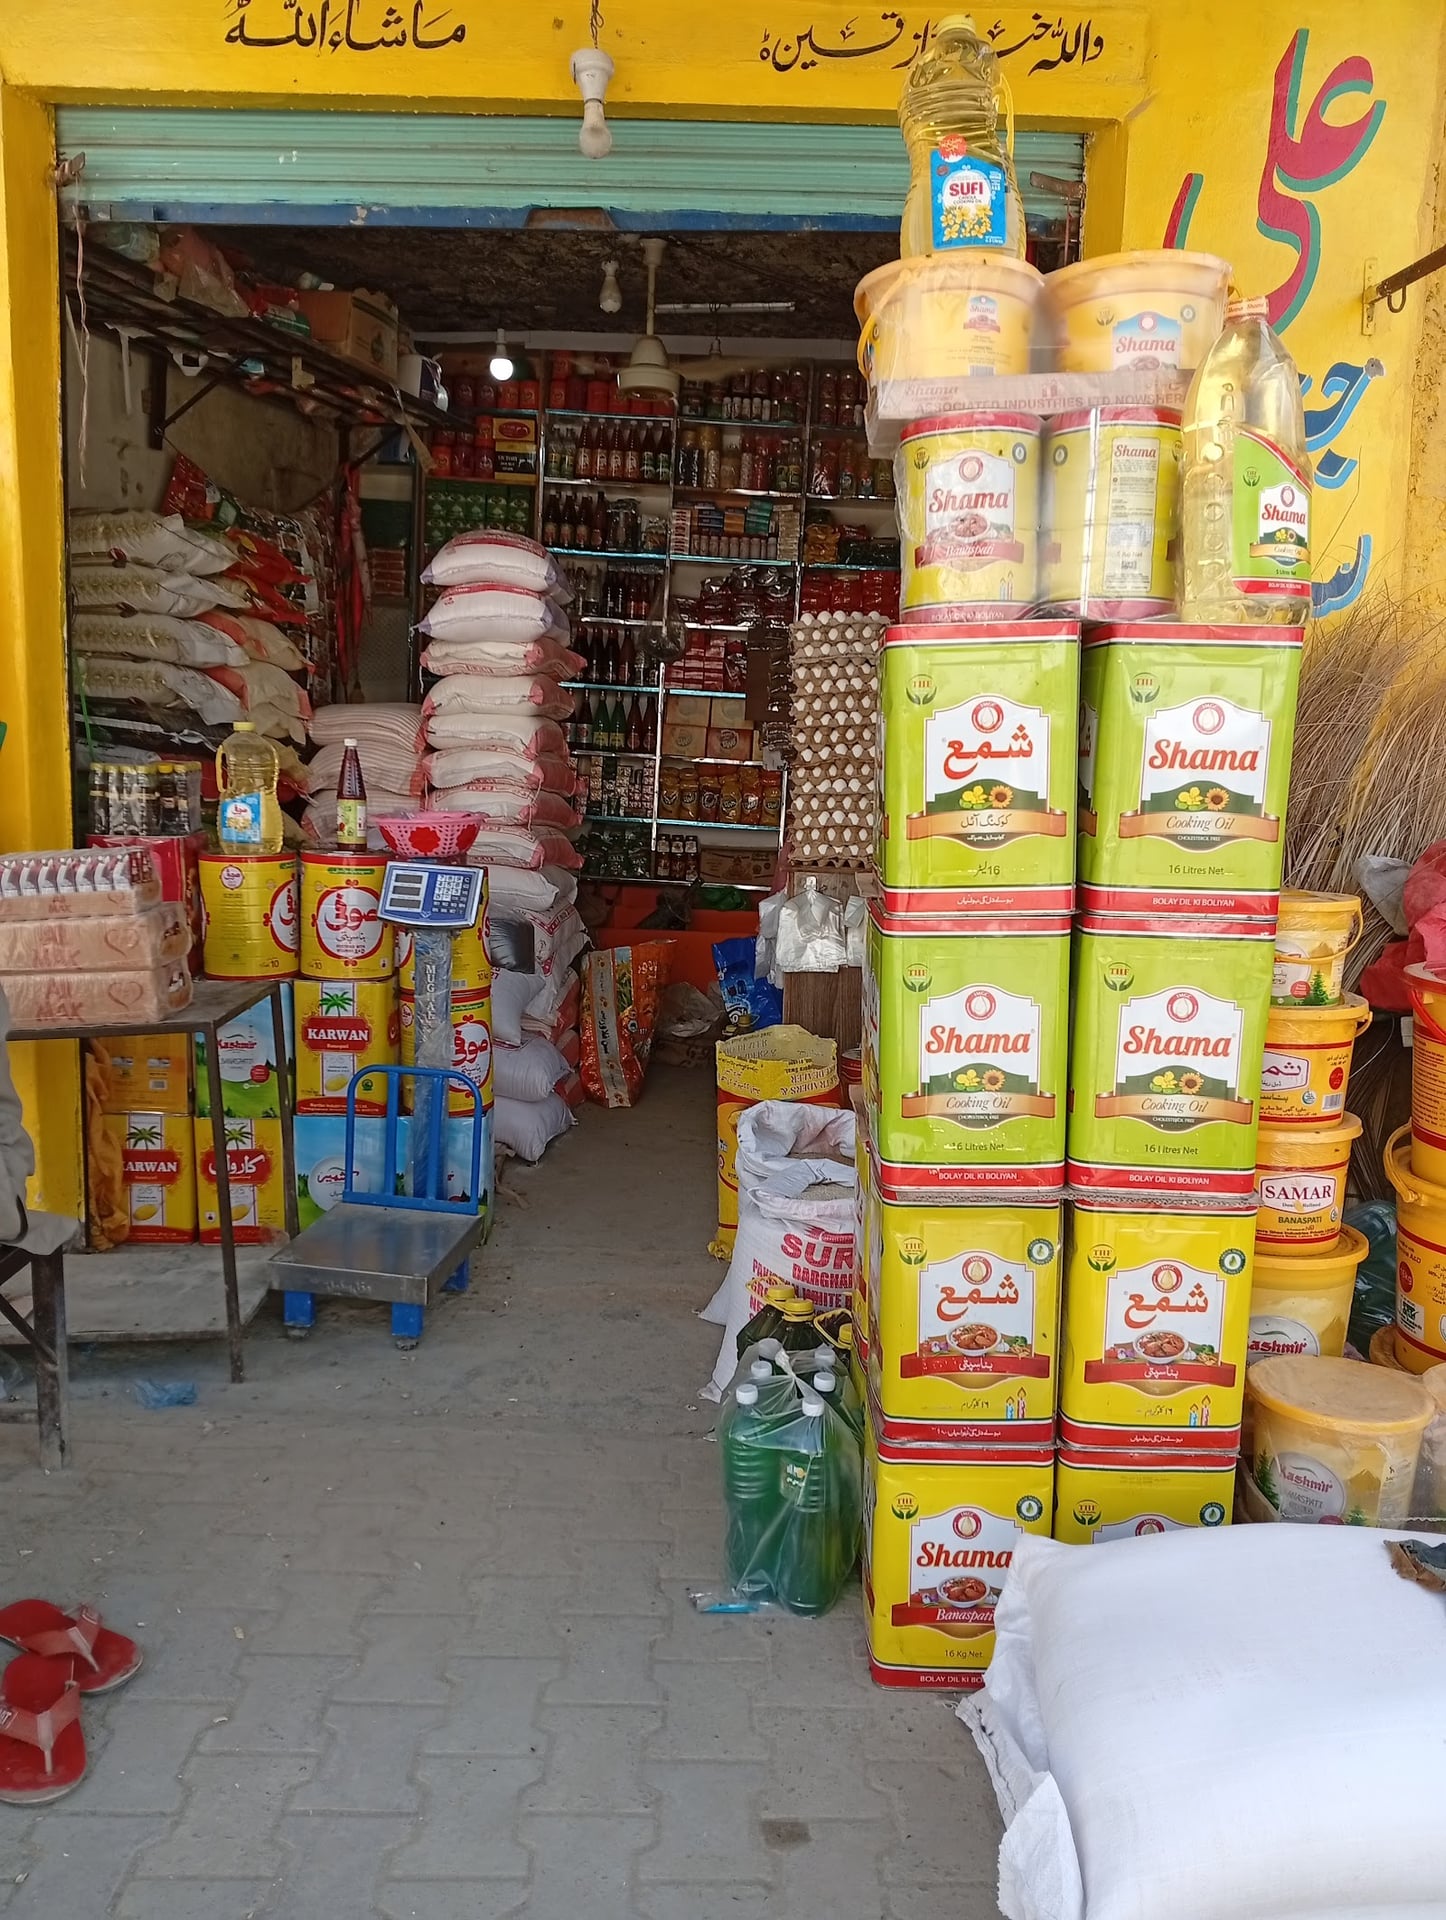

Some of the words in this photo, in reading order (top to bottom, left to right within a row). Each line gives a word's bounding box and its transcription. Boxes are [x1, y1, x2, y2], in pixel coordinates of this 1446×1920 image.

[949, 181, 983, 196] SUFI
[1115, 335, 1176, 354] Shama
[1004, 397, 1084, 409] INDUSTRIES
[1116, 393, 1185, 406] NOWSHER
[1114, 444, 1157, 458] Shama
[928, 488, 1010, 513] Shama
[1261, 503, 1307, 524] Shama
[943, 723, 1034, 780] شمع
[1149, 739, 1259, 772] Shama
[1166, 815, 1212, 831] Cooking
[1214, 816, 1236, 830] Oil
[989, 866, 1001, 875] 16
[1168, 864, 1180, 874] 16
[1182, 865, 1207, 874] Litres
[1208, 867, 1224, 875] Net
[1152, 897, 1178, 905] BOLAY
[1179, 898, 1192, 906] DIL
[1202, 899, 1235, 907] BOLIYAN
[271, 960, 280, 968] 10
[307, 1028, 369, 1041] KARWAN
[925, 1025, 1032, 1054] Shama
[1123, 1026, 1231, 1057] Shama
[790, 1079, 830, 1096] TRADERS
[946, 1097, 989, 1111] Cooking
[992, 1096, 1012, 1109] Oil
[1141, 1098, 1186, 1113] Cooking
[1188, 1100, 1209, 1113] Oil
[952, 1142, 963, 1151] 16
[965, 1142, 988, 1151] Litres
[989, 1143, 1005, 1151] Net
[1144, 1144, 1156, 1152] 16
[1158, 1145, 1181, 1154] Litres
[1183, 1146, 1199, 1155] Net
[938, 1172, 963, 1180] BOLAY
[964, 1172, 977, 1180] DIL
[1129, 1174, 1155, 1182] BOLAY
[1155, 1175, 1167, 1183] DIL
[1177, 1177, 1210, 1185] BOLIYAN
[1265, 1185, 1332, 1200] SAMAR
[1278, 1216, 1322, 1224] BANASPATI
[936, 1274, 1020, 1322] شمع
[1124, 1283, 1209, 1329] شمع
[1249, 1339, 1308, 1354] ashmir
[916, 1541, 1014, 1569] Shama
[935, 1608, 994, 1623] Banaspati
[945, 1649, 955, 1658] 16
[957, 1650, 967, 1659] Kg
[968, 1650, 983, 1658] Net
[920, 1675, 946, 1683] BOLAY
